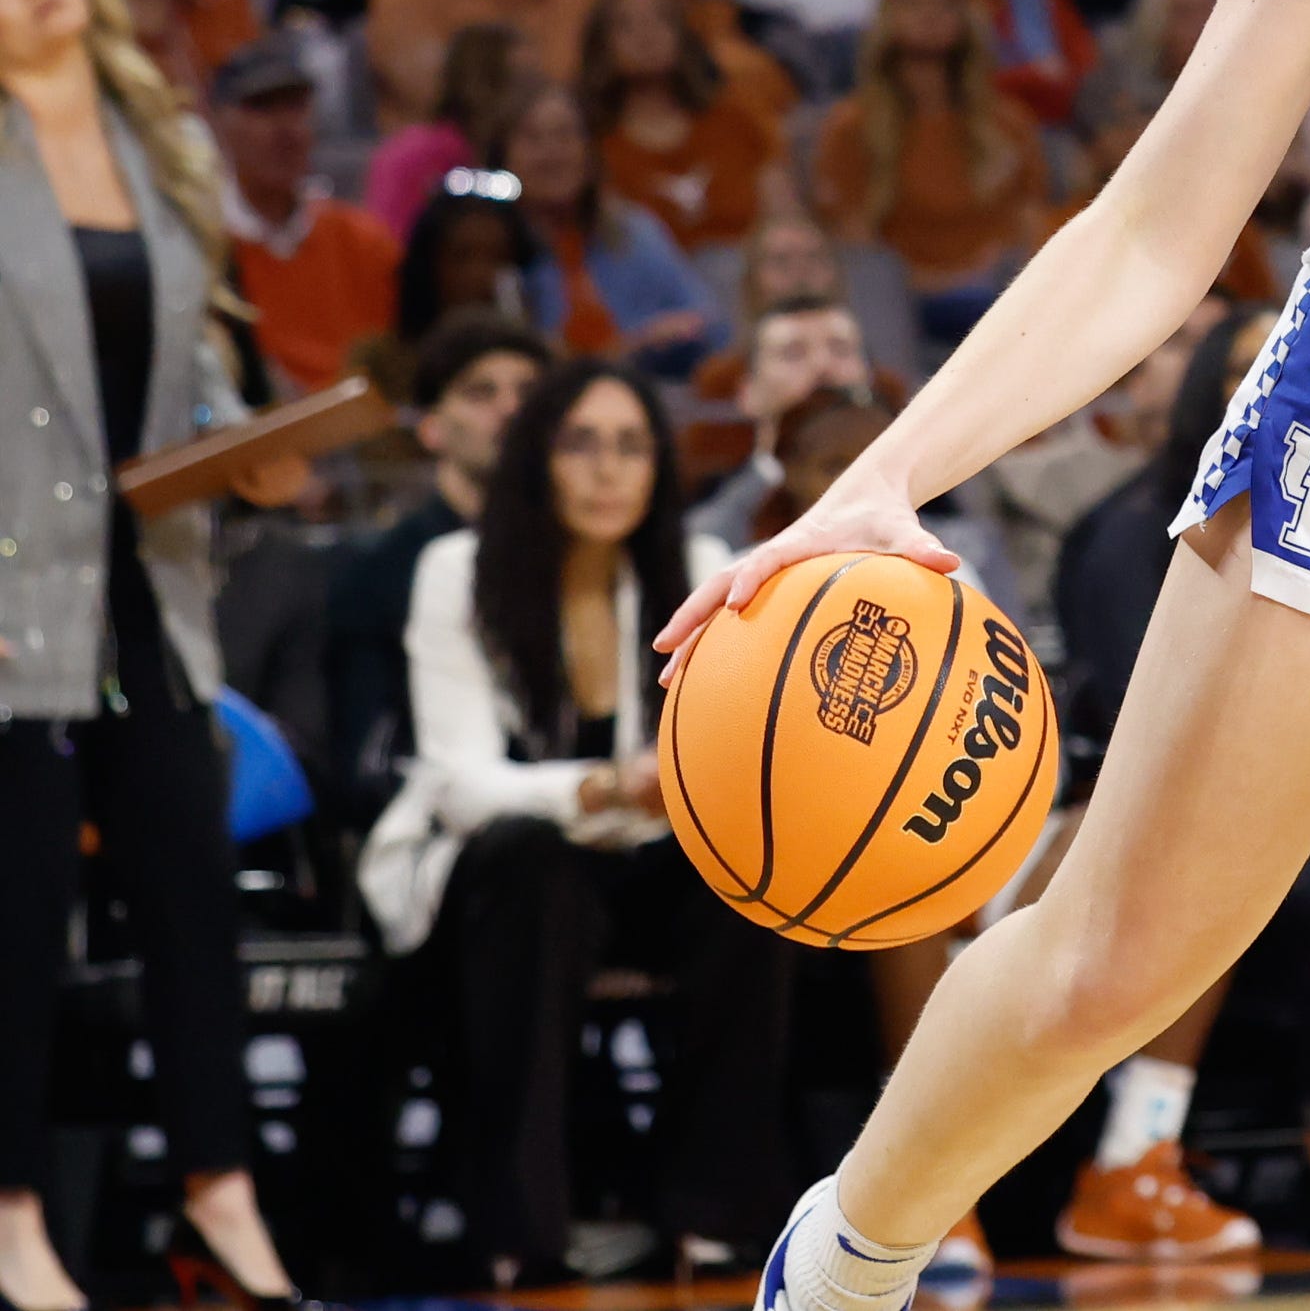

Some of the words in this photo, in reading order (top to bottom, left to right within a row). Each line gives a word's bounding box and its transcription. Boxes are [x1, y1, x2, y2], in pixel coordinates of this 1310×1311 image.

[824, 631, 877, 733] MADNESS
[857, 630, 901, 705] MARCH
[963, 669, 978, 705] EVO
[902, 617, 1031, 845] Wilson
[947, 707, 968, 746] NXT
